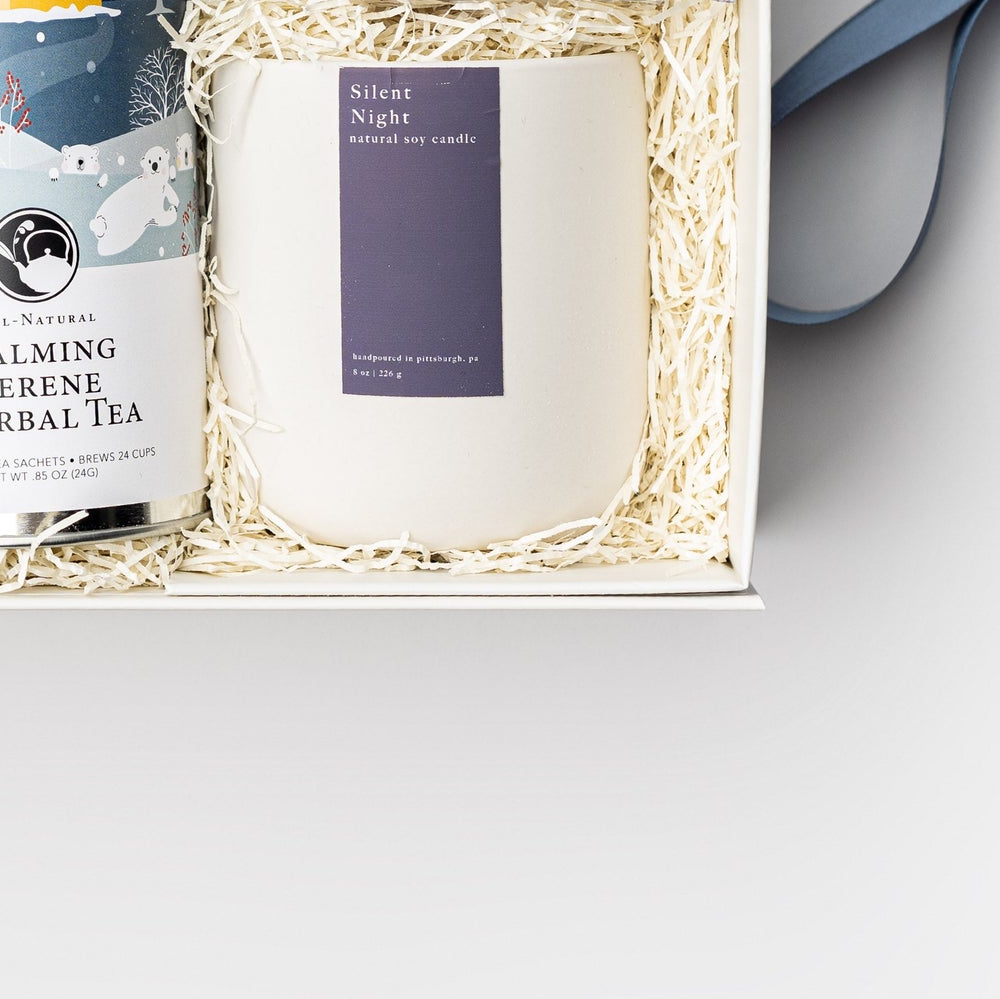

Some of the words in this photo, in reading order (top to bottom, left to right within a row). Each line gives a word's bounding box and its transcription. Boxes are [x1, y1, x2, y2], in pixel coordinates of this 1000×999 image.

[351, 84, 411, 99] Silent
[351, 109, 409, 128] Night
[349, 133, 398, 144] natural
[403, 135, 427, 147] soy
[431, 133, 477, 144] candle
[352, 352, 402, 363] handpoured
[468, 356, 479, 364] pa
[352, 368, 358, 376] 8
[378, 369, 394, 378] 226
[396, 371, 402, 380] g
[13, 456, 66, 469] SACHETS
[78, 451, 116, 465] BREWS
[118, 450, 130, 461] 24
[131, 446, 156, 459] CUPS
[10, 471, 28, 482] WT
[32, 470, 48, 481] .85
[50, 469, 68, 481] OZ
[70, 467, 99, 480] (24G)
